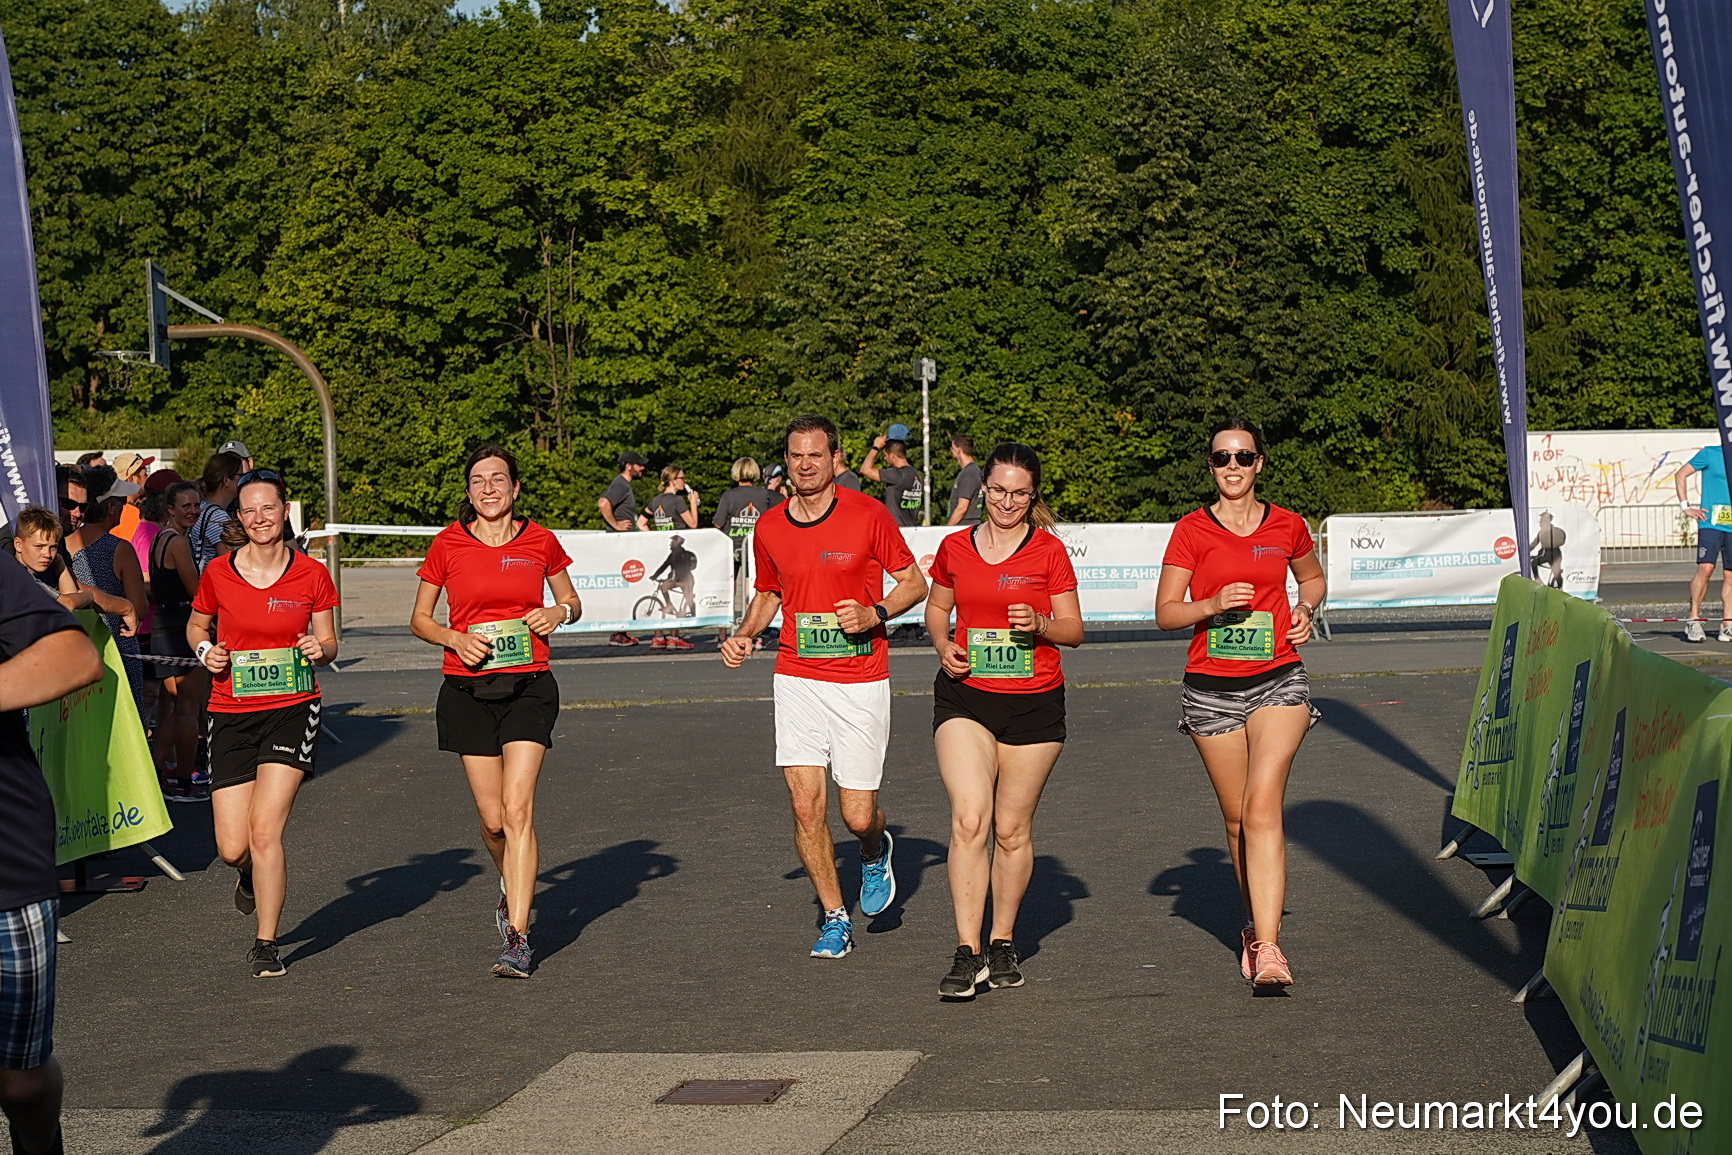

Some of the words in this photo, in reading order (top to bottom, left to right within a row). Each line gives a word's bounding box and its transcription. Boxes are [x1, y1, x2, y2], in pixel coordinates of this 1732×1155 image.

[1351, 537, 1385, 549] NOW
[1066, 546, 1088, 557] OW
[1353, 559, 1402, 571] E-BIKES
[1404, 558, 1414, 568] &
[1417, 552, 1496, 567] FAHRRÄDER
[571, 575, 624, 588] RRÄDER
[1109, 568, 1120, 579] &
[1123, 568, 1161, 579] FAHR
[496, 635, 517, 652] 08
[810, 628, 841, 644] 107
[1223, 628, 1257, 644] 237
[522, 636, 531, 658] 2022
[984, 646, 1017, 662] 110
[248, 665, 280, 681] 109
[285, 665, 293, 688] 2022
